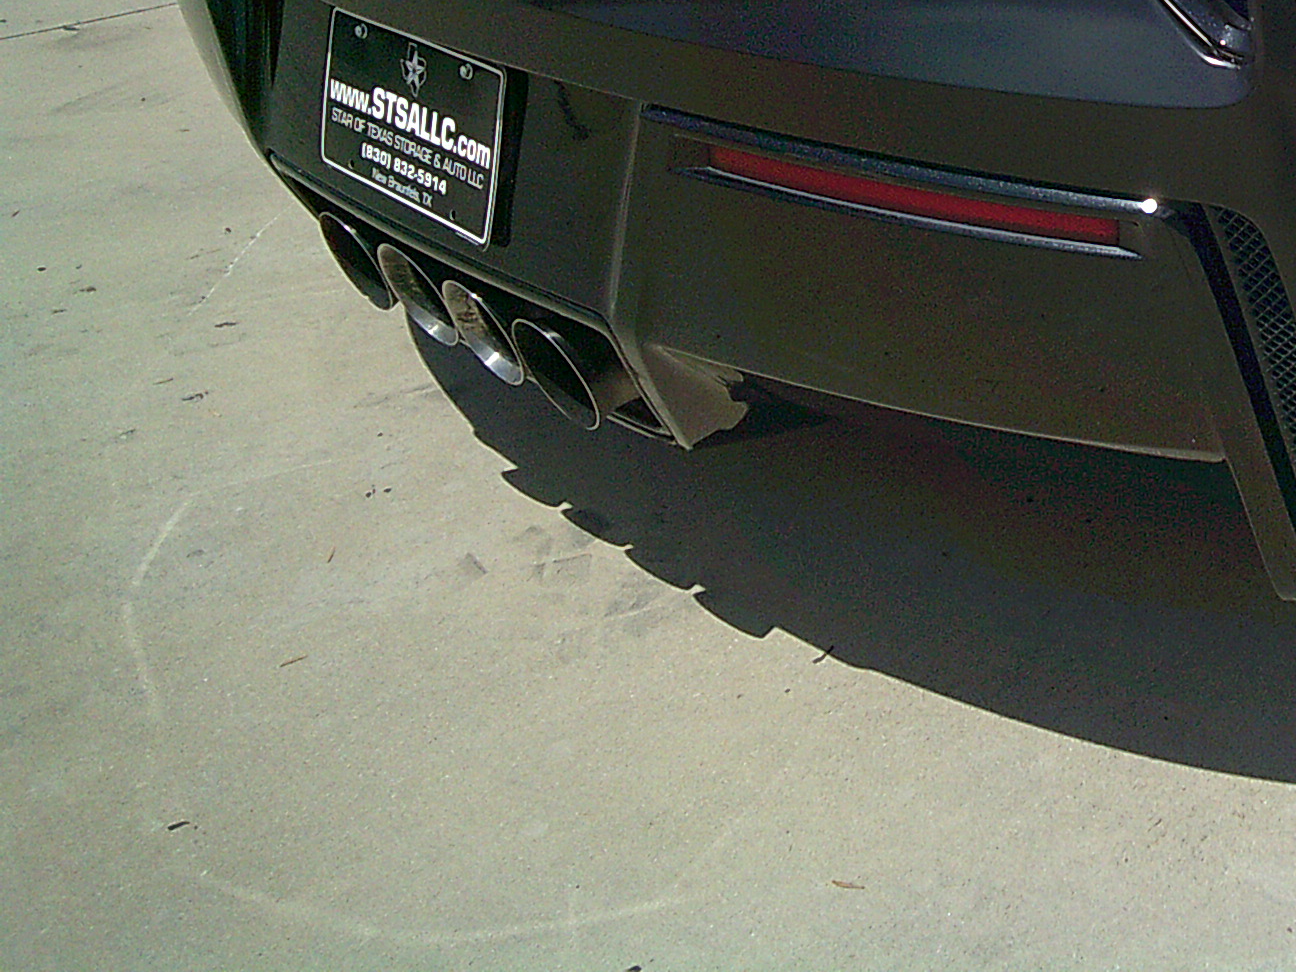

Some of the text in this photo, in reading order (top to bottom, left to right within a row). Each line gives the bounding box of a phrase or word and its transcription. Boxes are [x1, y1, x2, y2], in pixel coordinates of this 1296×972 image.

[329, 78, 491, 169] www.STSALLC.com
[331, 107, 485, 190] STAR OF TEXAS STORAGE & AUTO LLC
[393, 157, 447, 196] 832-5914
[421, 191, 433, 208] TX
